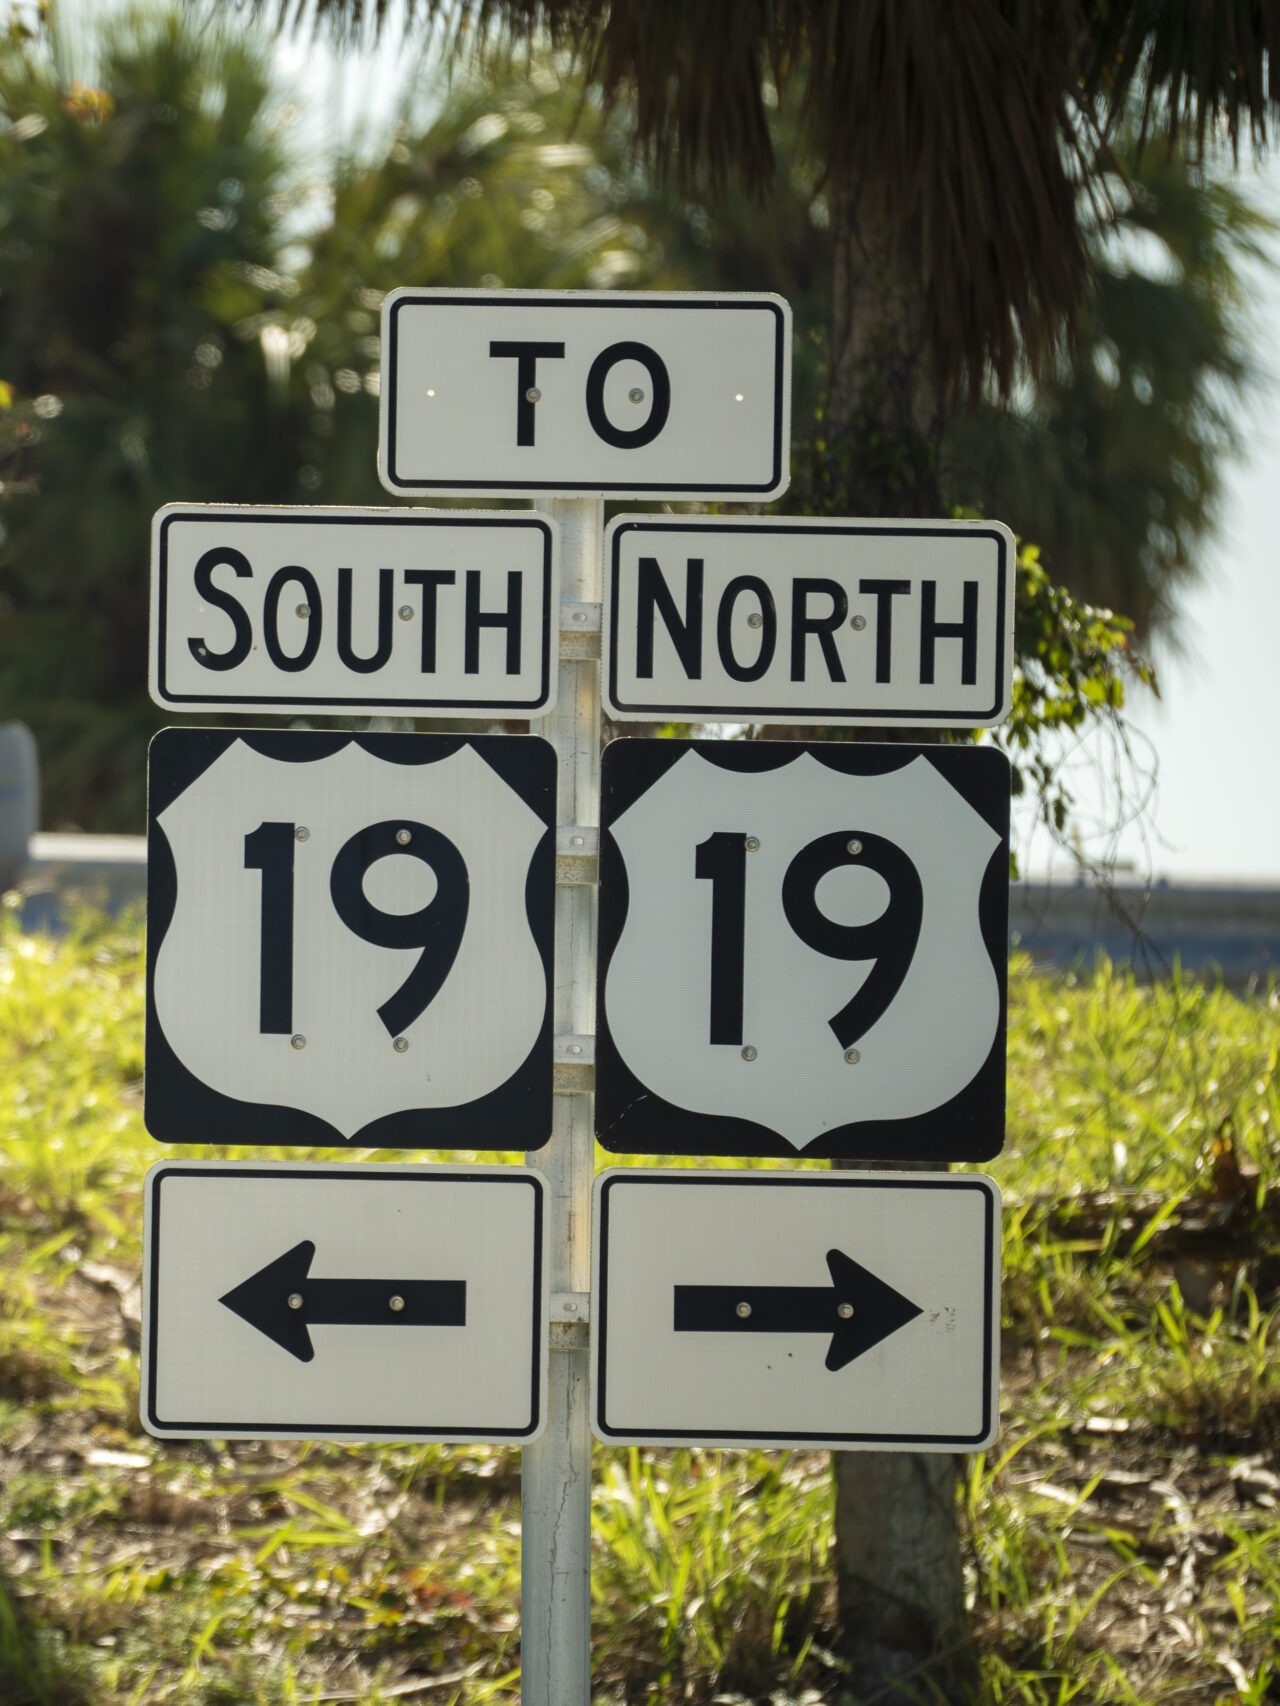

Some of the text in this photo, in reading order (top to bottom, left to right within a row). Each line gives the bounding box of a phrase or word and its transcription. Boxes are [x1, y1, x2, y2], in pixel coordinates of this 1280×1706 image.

[489, 341, 671, 449] TO
[187, 546, 522, 675] SOUTH
[635, 557, 979, 686] NORTH
[244, 819, 470, 1039] 19
[694, 830, 924, 1051] 19
